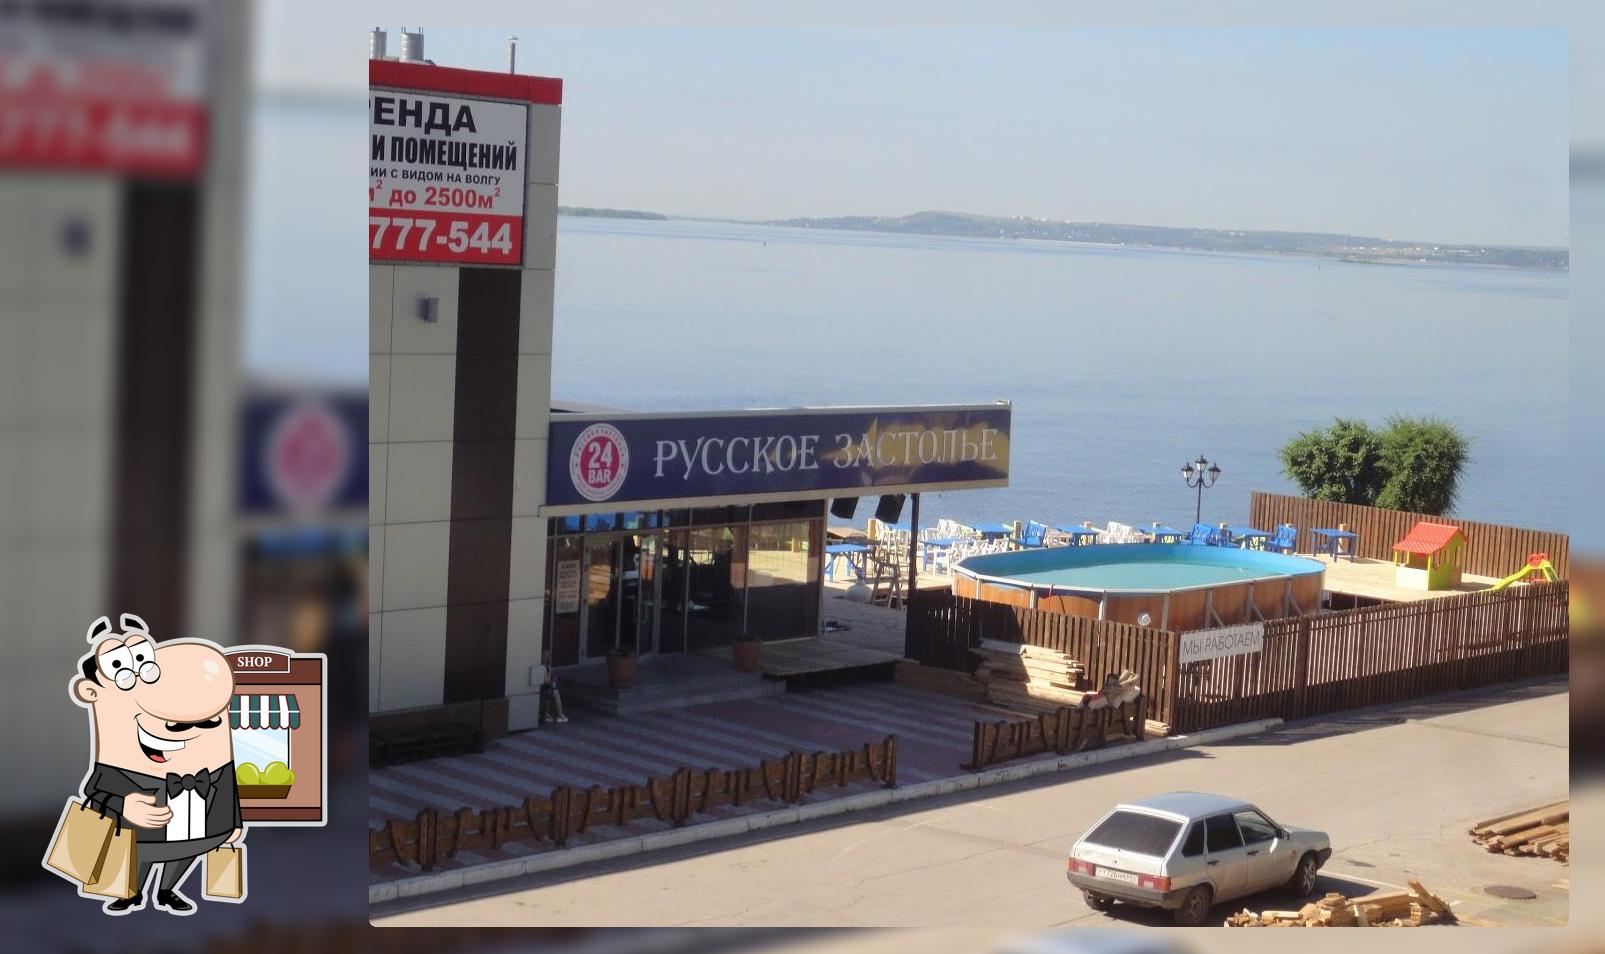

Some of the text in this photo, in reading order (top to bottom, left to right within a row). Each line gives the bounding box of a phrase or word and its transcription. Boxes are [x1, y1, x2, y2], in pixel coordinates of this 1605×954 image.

[369, 96, 477, 136] ЕНДА
[390, 136, 517, 171] ПОМЕЩЕНИЙ
[390, 169, 399, 179] С
[402, 170, 443, 182] ВИДОМ
[447, 173, 462, 184] НА
[465, 174, 501, 186] ВОЛГУ
[369, 216, 513, 255] 777-544
[588, 441, 612, 468] 24
[653, 435, 820, 481] РУССКОЕ
[833, 428, 998, 469] ЗАСТОЛЬЕ
[588, 468, 611, 484] BAR
[1183, 640, 1202, 656] МЫ
